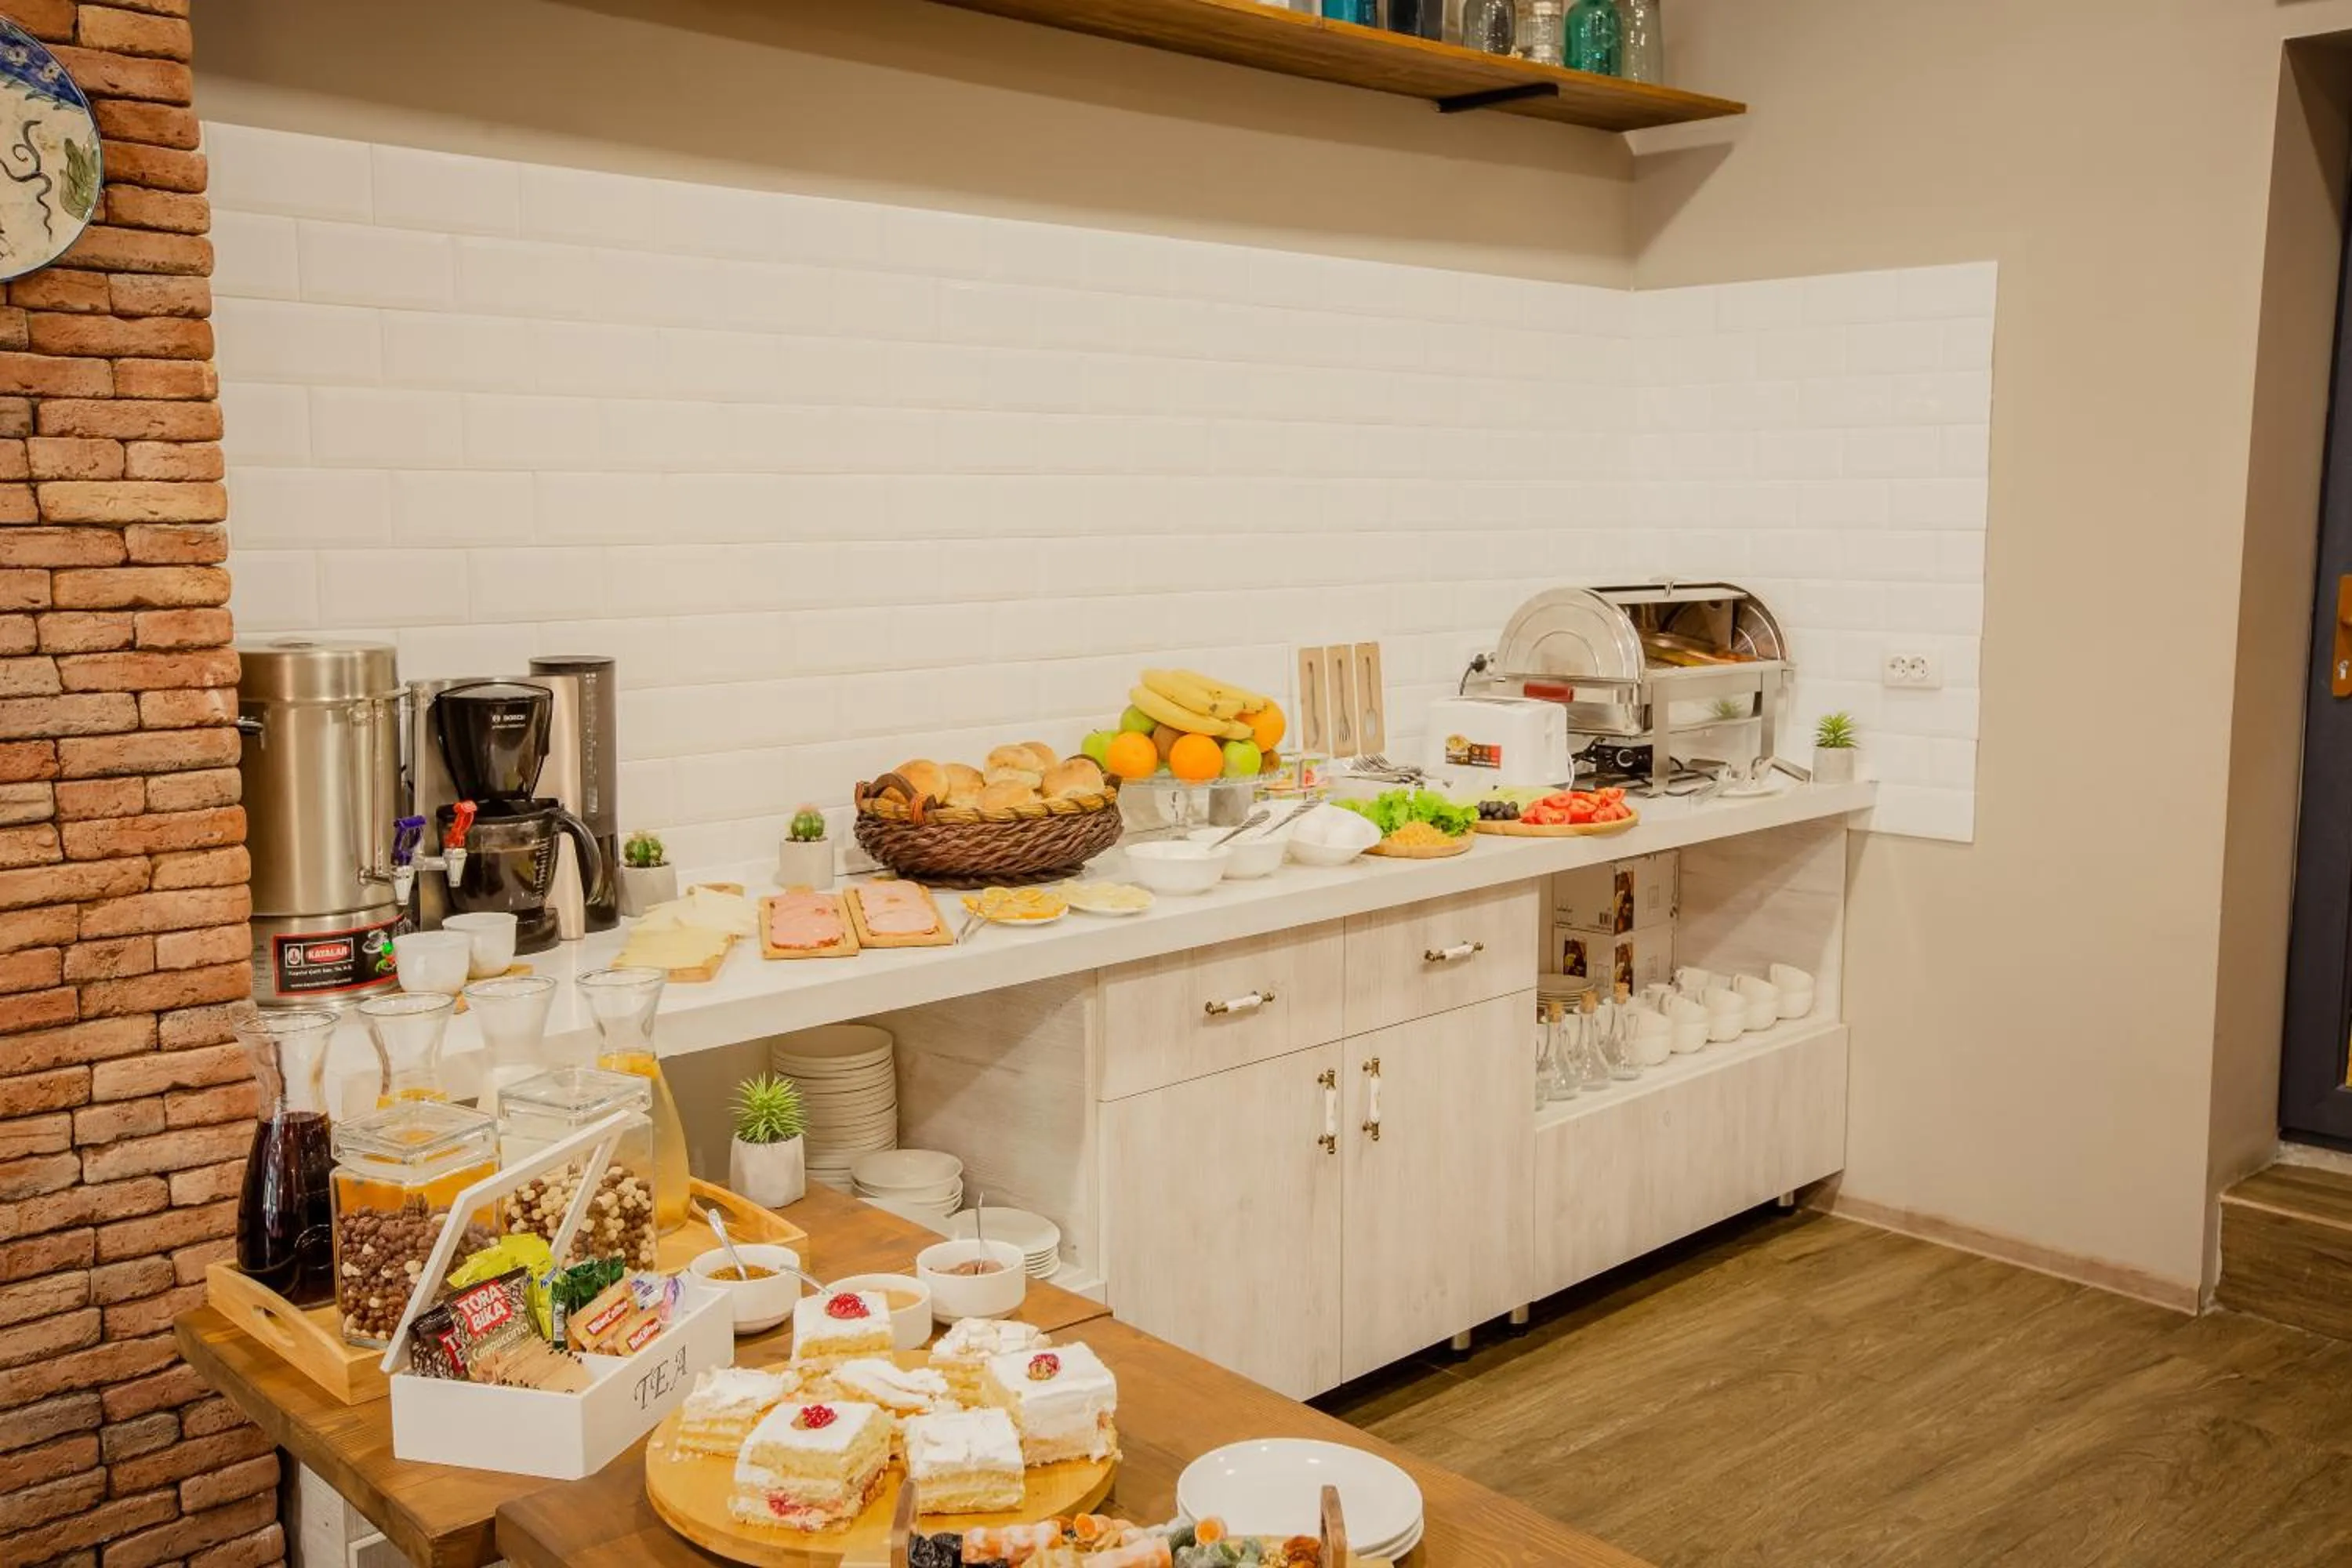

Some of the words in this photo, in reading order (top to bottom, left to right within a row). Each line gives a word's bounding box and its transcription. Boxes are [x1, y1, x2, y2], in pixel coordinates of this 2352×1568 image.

[308, 946, 348, 960] KAYALAR
[457, 1284, 503, 1315] TORA
[472, 1301, 508, 1332] BIKA
[634, 1345, 688, 1410] TEA
